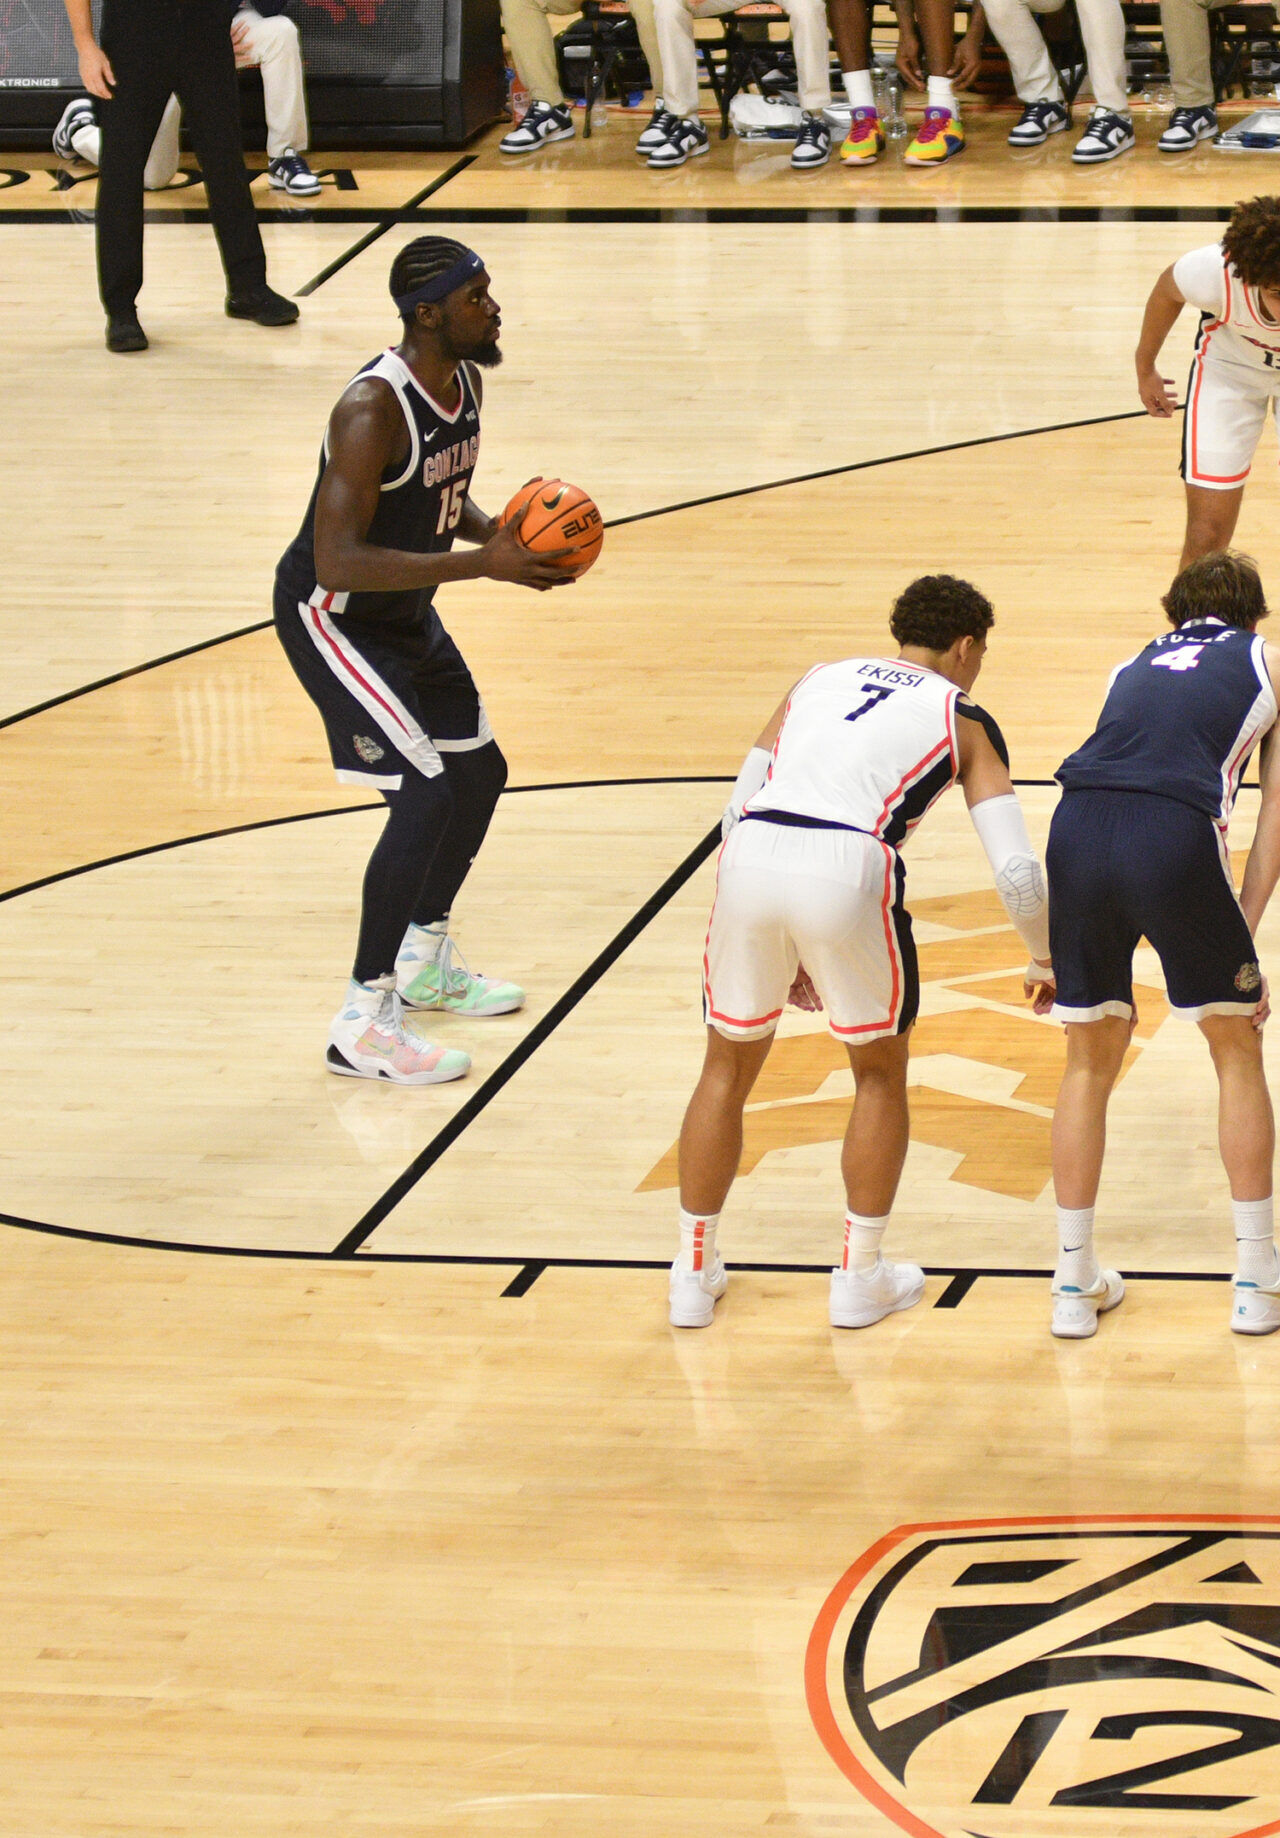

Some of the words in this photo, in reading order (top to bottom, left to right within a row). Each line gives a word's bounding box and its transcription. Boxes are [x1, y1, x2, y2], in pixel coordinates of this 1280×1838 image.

[436, 478, 467, 535] 15
[560, 507, 600, 540] ELITE
[1150, 644, 1207, 672] 4
[857, 664, 925, 688] EKISSI
[843, 683, 896, 722] 7
